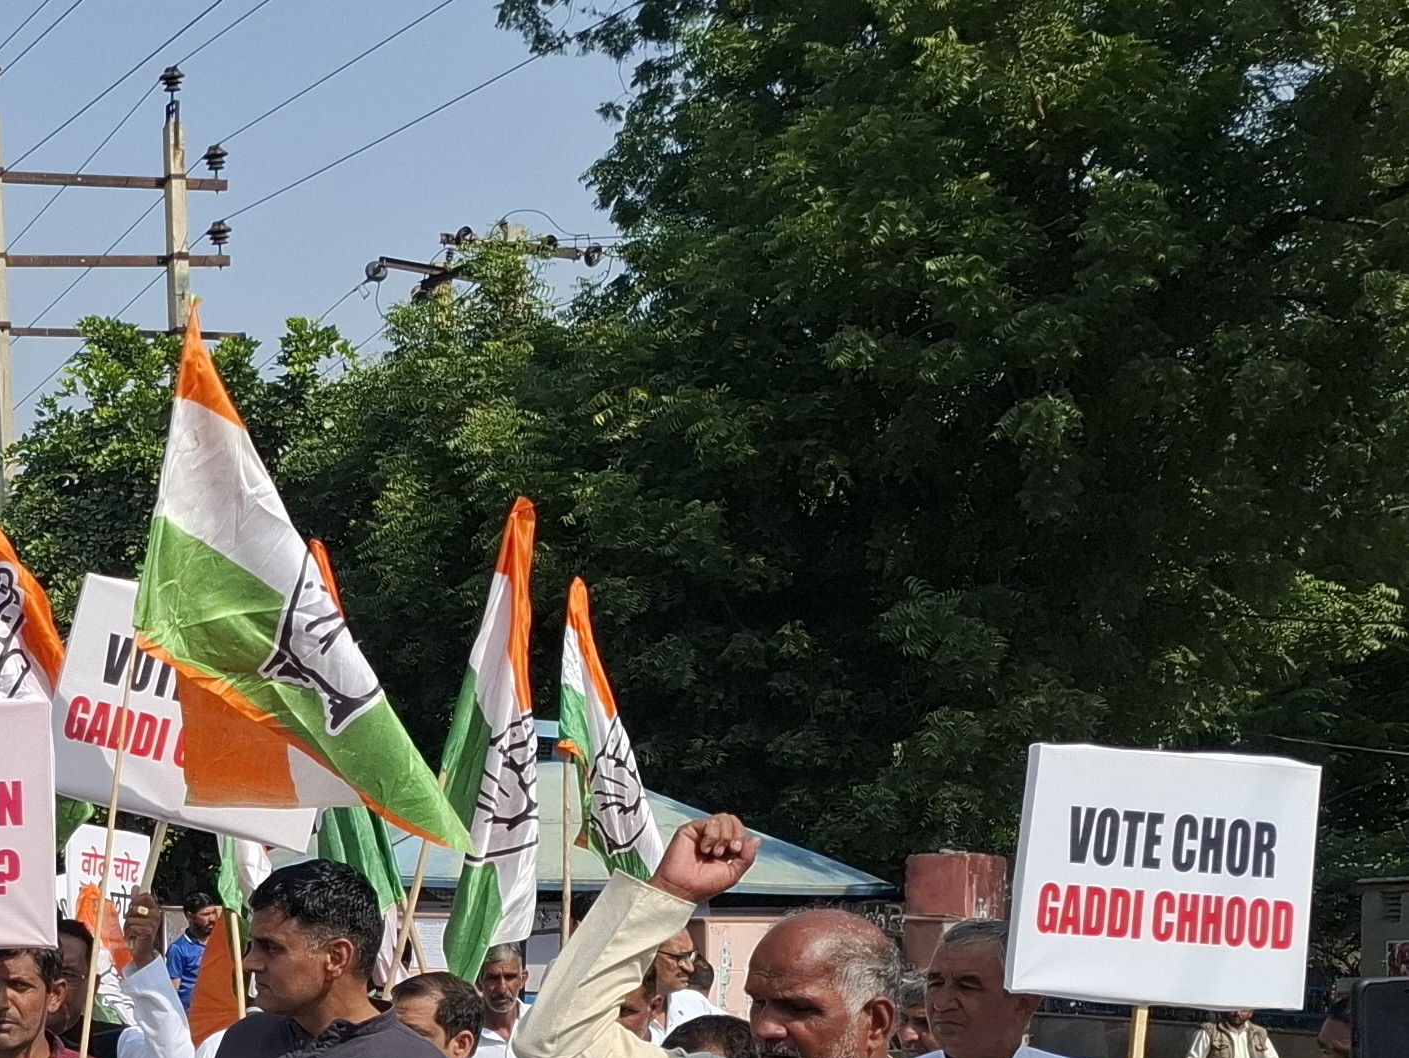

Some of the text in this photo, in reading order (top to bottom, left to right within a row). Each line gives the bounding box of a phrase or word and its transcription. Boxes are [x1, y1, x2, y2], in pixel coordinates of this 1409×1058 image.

[64, 695, 172, 762] GADDI
[1069, 806, 1277, 878] VOTE CHOR
[1036, 882, 1294, 950] GADDI CHHOOD
